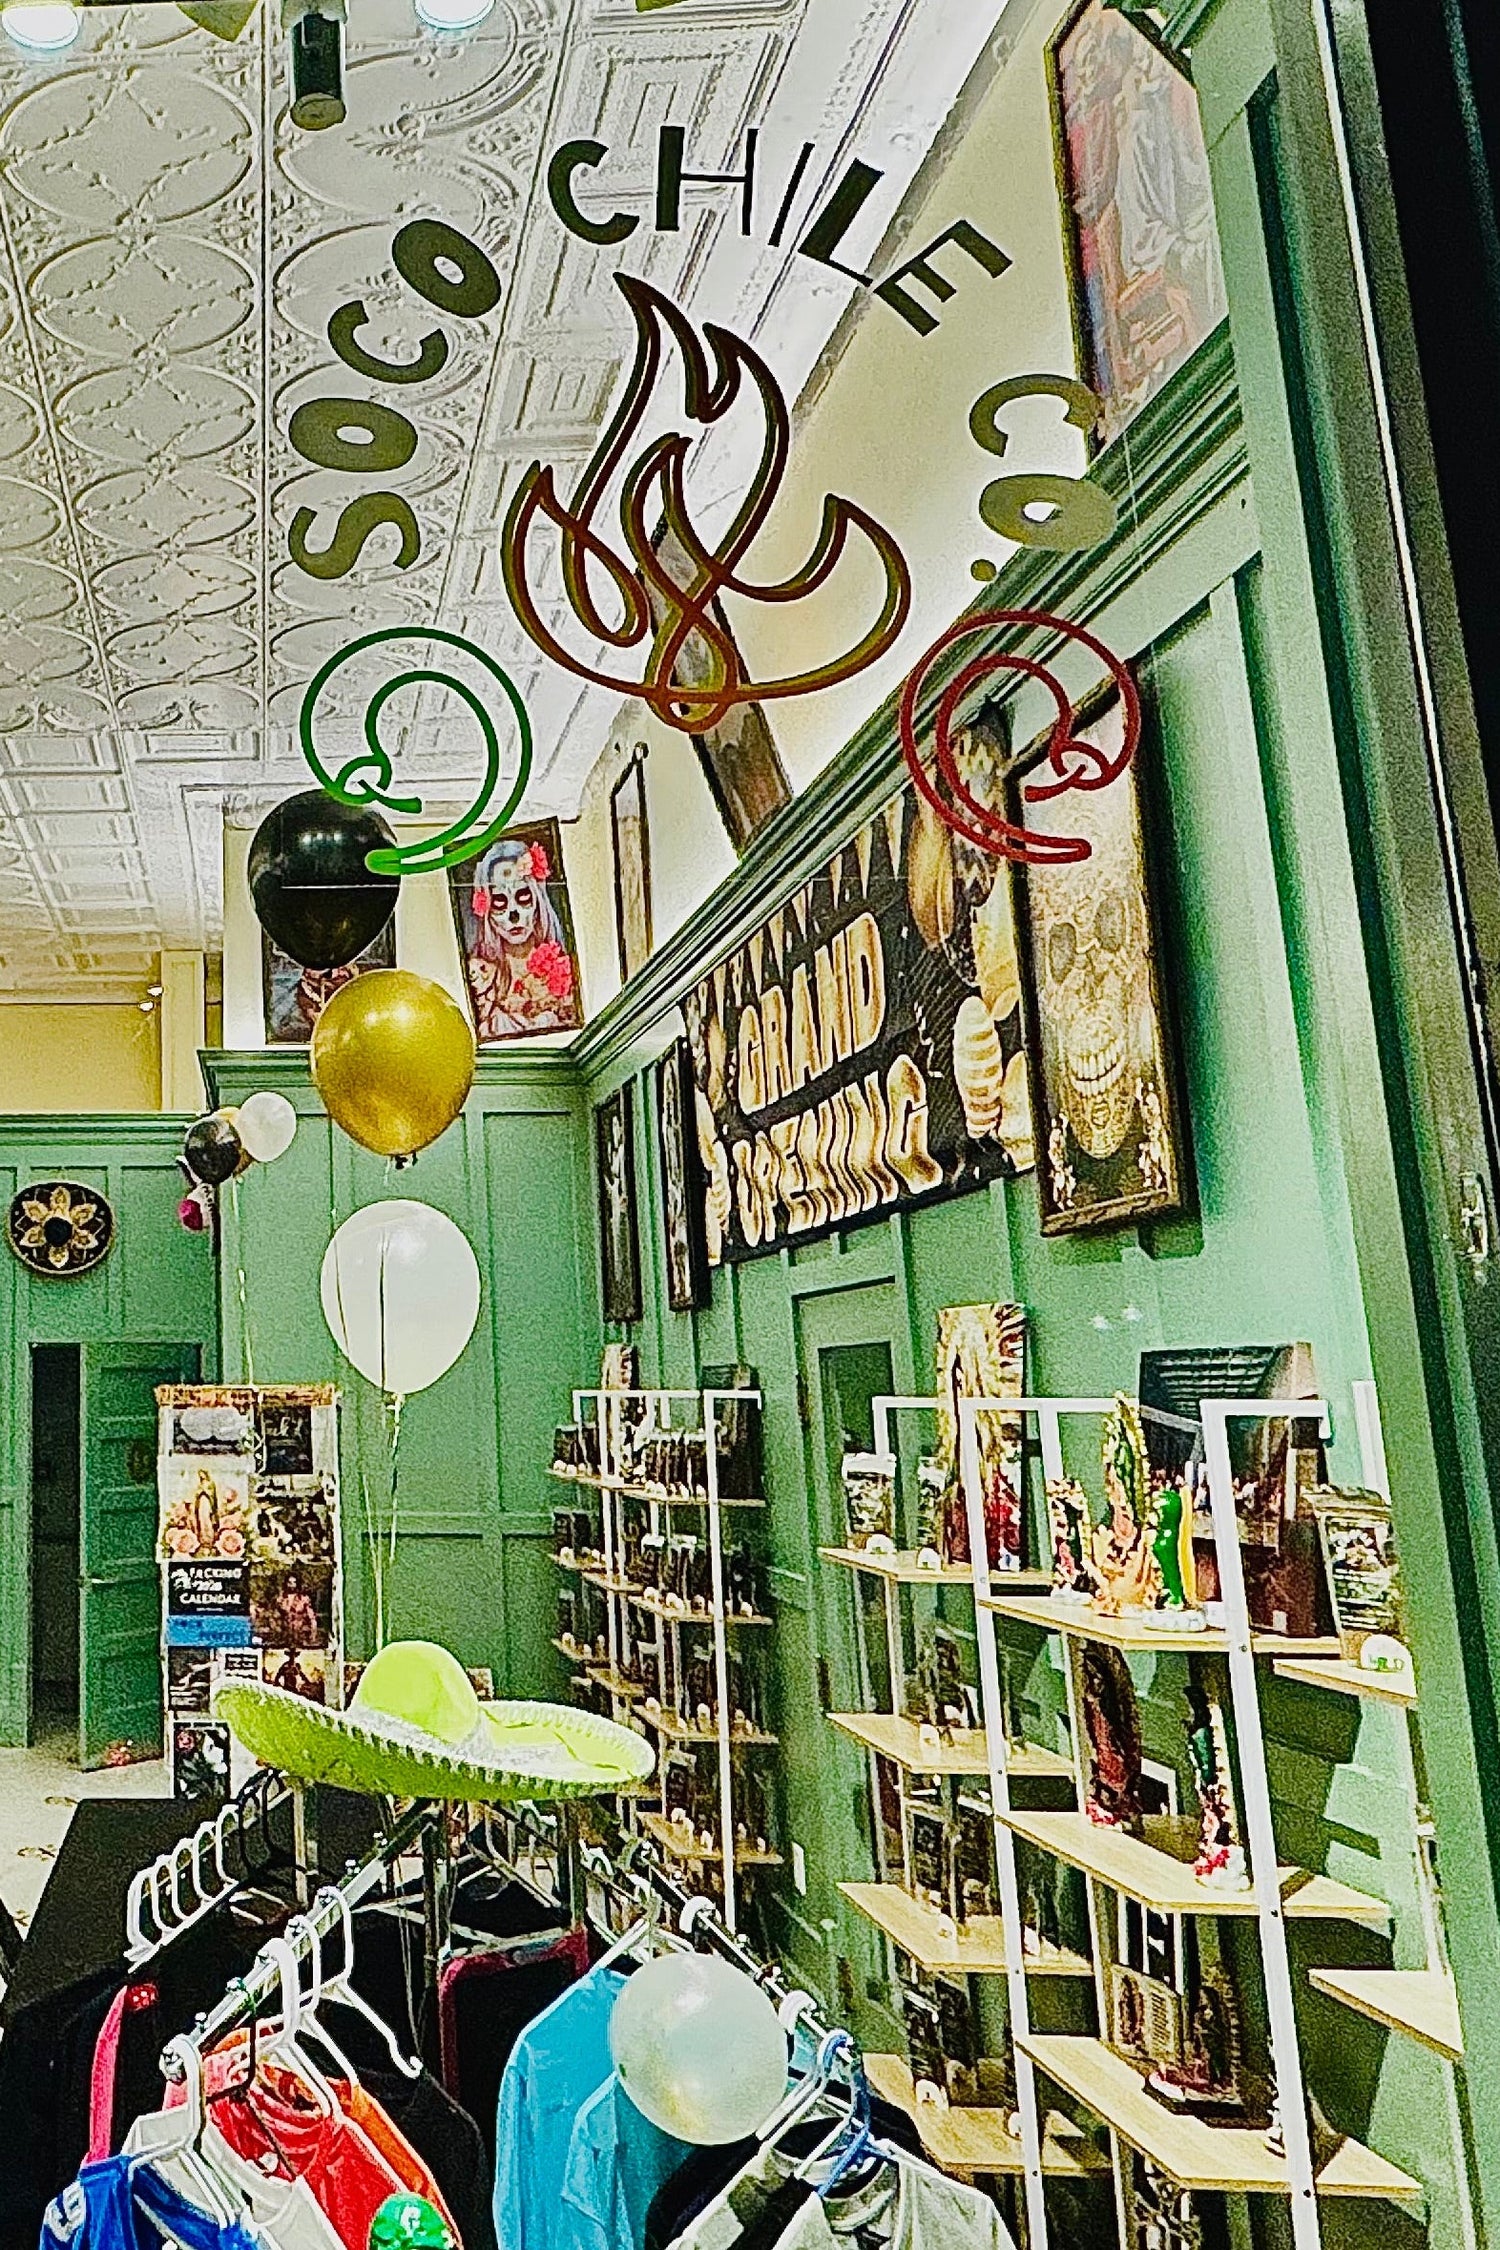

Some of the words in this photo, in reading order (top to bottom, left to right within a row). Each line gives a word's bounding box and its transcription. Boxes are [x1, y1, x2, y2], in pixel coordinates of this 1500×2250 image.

[287, 217, 502, 581] SOCO
[546, 125, 1014, 338] CHILE
[737, 911, 886, 1116] GRAND
[730, 1053, 944, 1249] OPENING
[179, 1592, 242, 1605] CALENDAR
